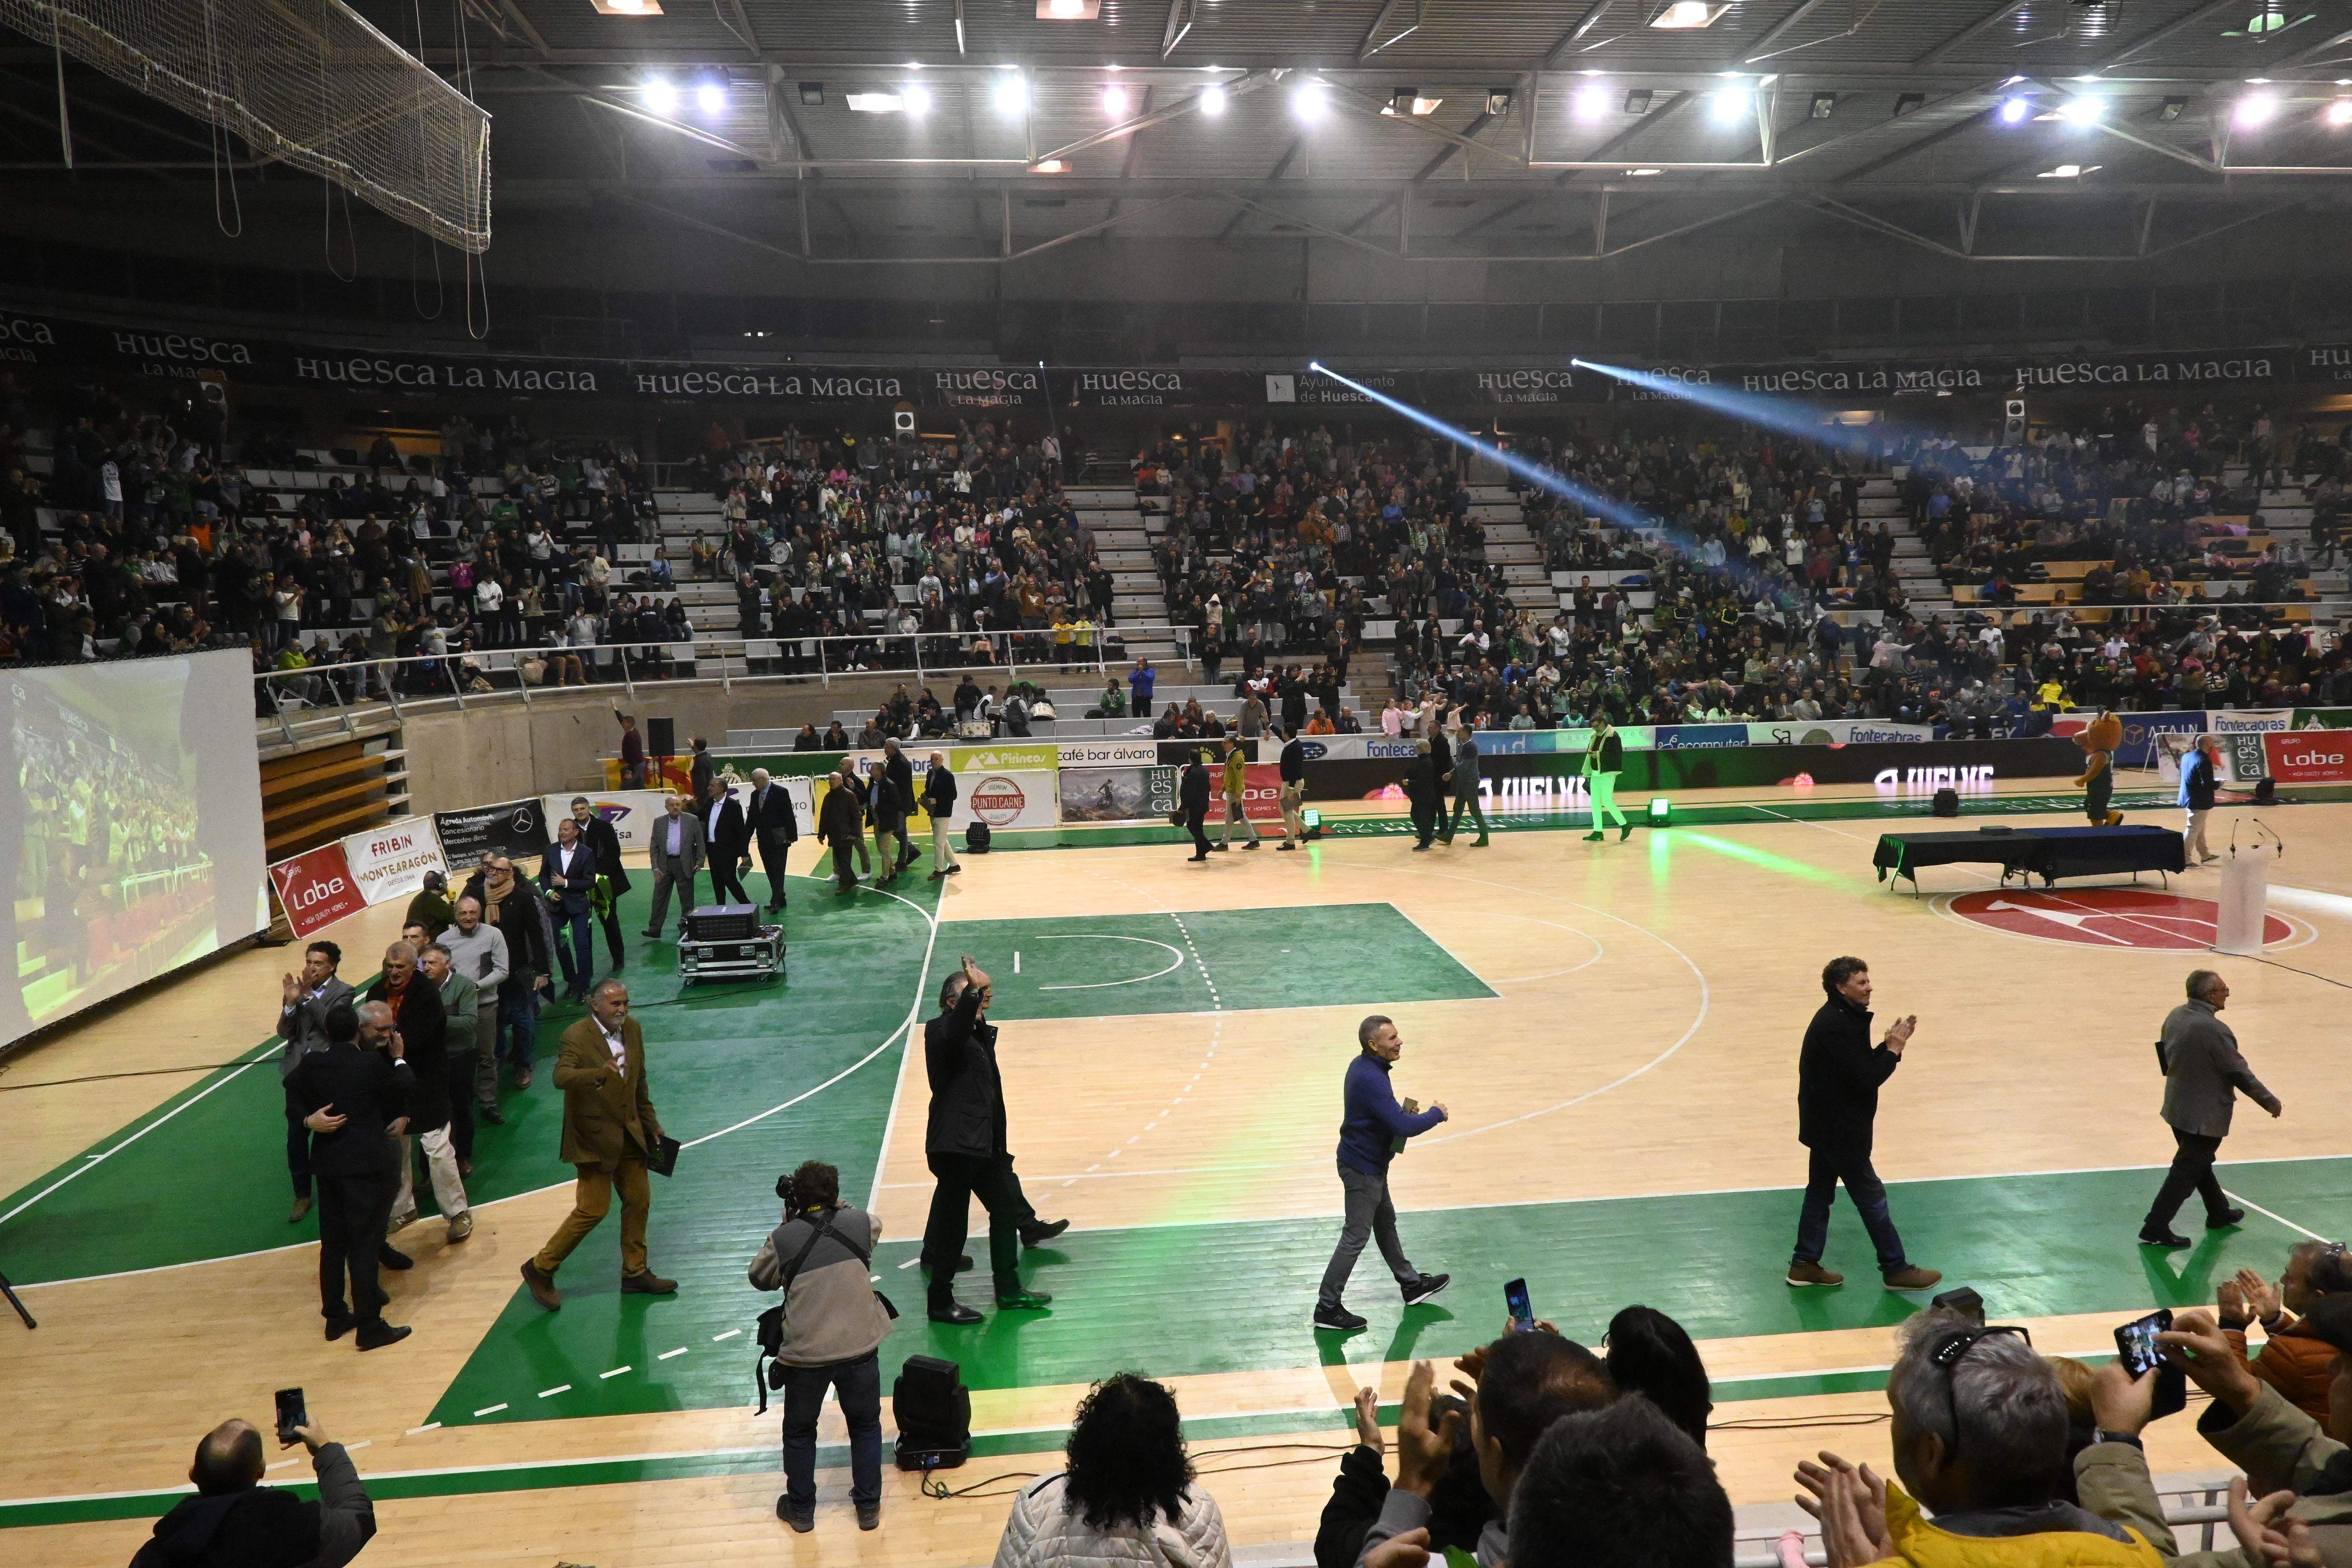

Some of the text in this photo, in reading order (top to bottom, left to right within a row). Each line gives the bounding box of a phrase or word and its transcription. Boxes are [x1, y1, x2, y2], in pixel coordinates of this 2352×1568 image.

[1301, 390, 1373, 403] de Huesca
[1057, 747, 1155, 761] café bar álvaro
[2283, 750, 2344, 766] Lobe
[973, 797, 1023, 808] PUNTO CARNE
[441, 825, 485, 836] Concesionario
[371, 834, 413, 857] FRIBIN
[444, 834, 487, 846] Mercedes-Benz
[357, 852, 438, 882] MONTEARAGÓN
[388, 873, 415, 887] DESDE 1966
[293, 877, 345, 910] Lobe
